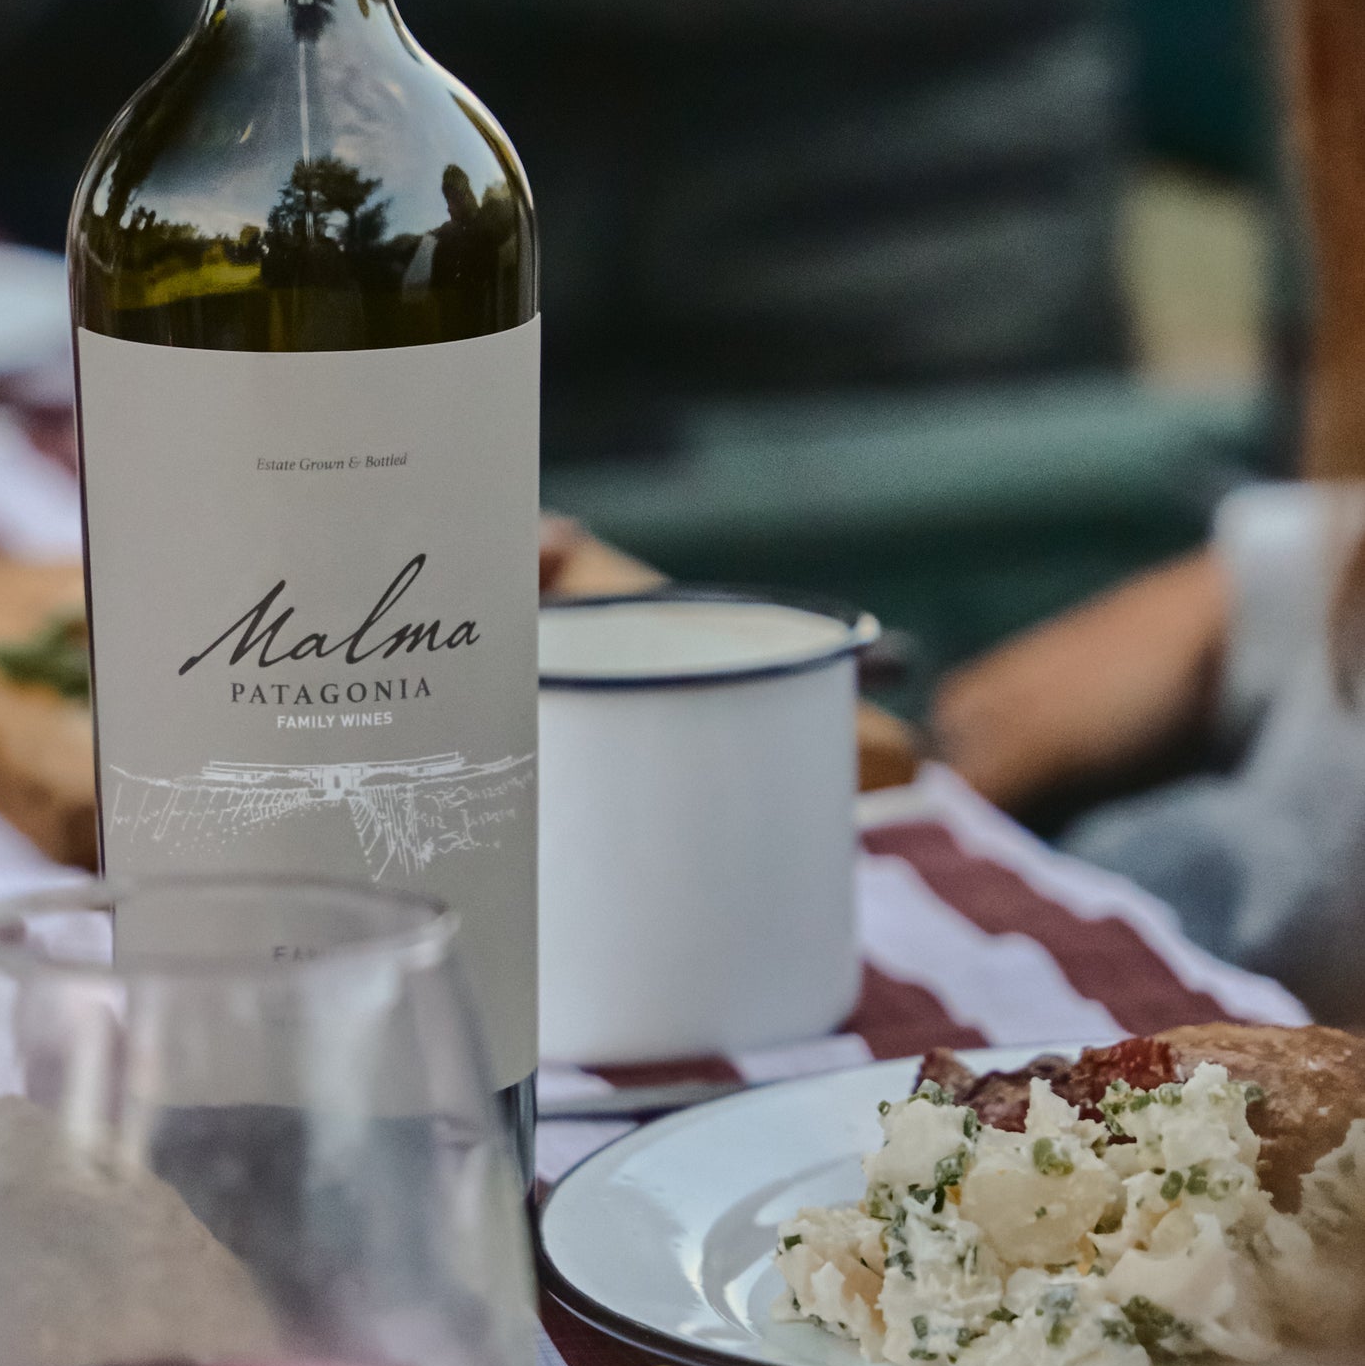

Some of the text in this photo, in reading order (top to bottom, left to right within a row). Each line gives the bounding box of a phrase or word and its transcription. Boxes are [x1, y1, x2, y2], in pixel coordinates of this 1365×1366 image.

[256, 452, 408, 471] Estate Grown & Bottled
[178, 553, 480, 676] Malma
[231, 677, 432, 705] PATAGONIA
[277, 712, 393, 729] FAMILY WINES
